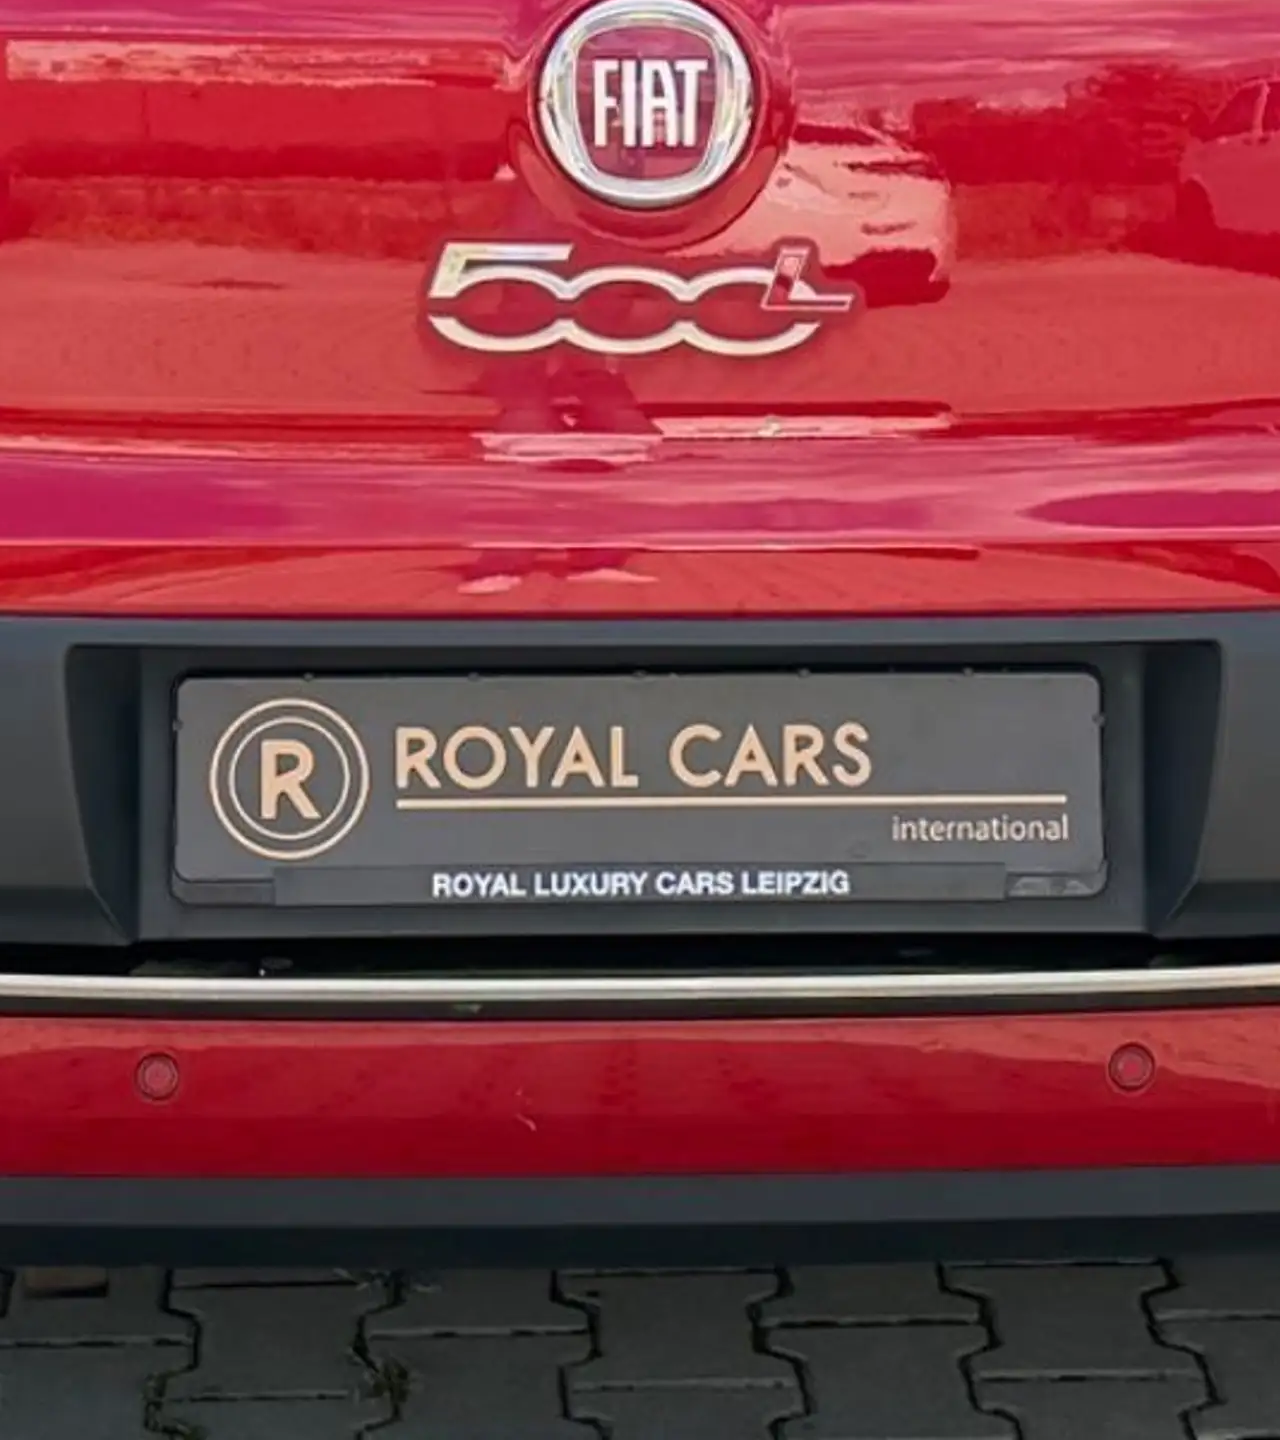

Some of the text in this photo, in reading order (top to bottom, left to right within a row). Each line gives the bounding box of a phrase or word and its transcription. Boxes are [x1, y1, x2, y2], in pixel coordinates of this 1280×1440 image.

[592, 59, 709, 149] FIAT
[259, 737, 321, 821] R
[395, 721, 873, 789] ROYAL CARS
[891, 812, 1070, 843] international
[431, 868, 850, 897] ROYAL LUXURY CARS LEIPZIG
